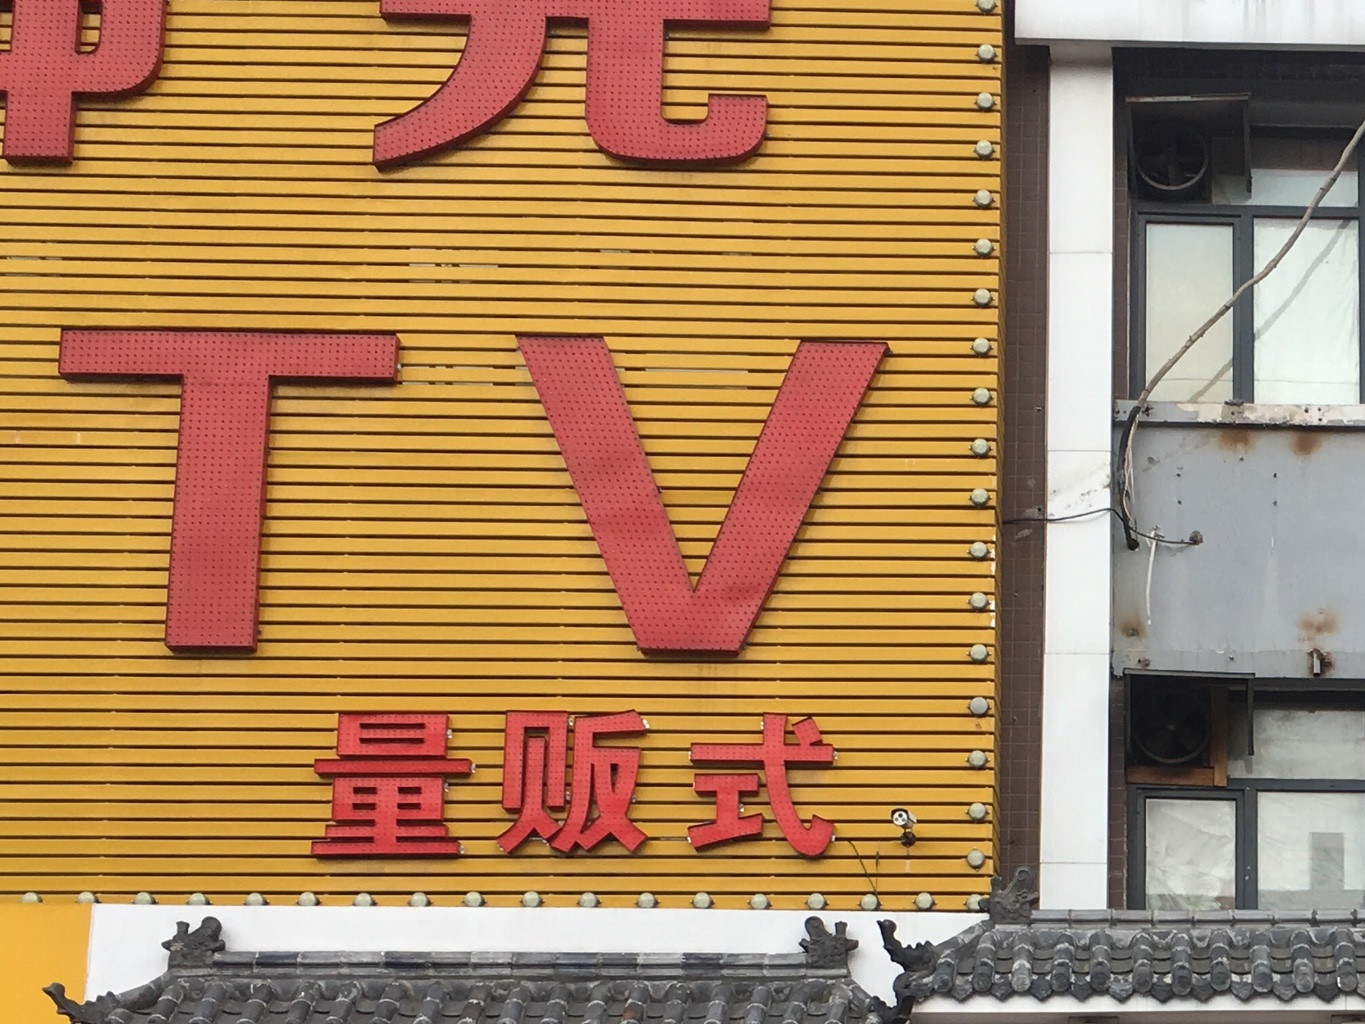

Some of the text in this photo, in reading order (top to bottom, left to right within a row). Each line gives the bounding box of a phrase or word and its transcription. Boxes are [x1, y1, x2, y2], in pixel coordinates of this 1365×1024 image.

[58, 328, 890, 655] TV
[311, 709, 837, 859] 量贩式
